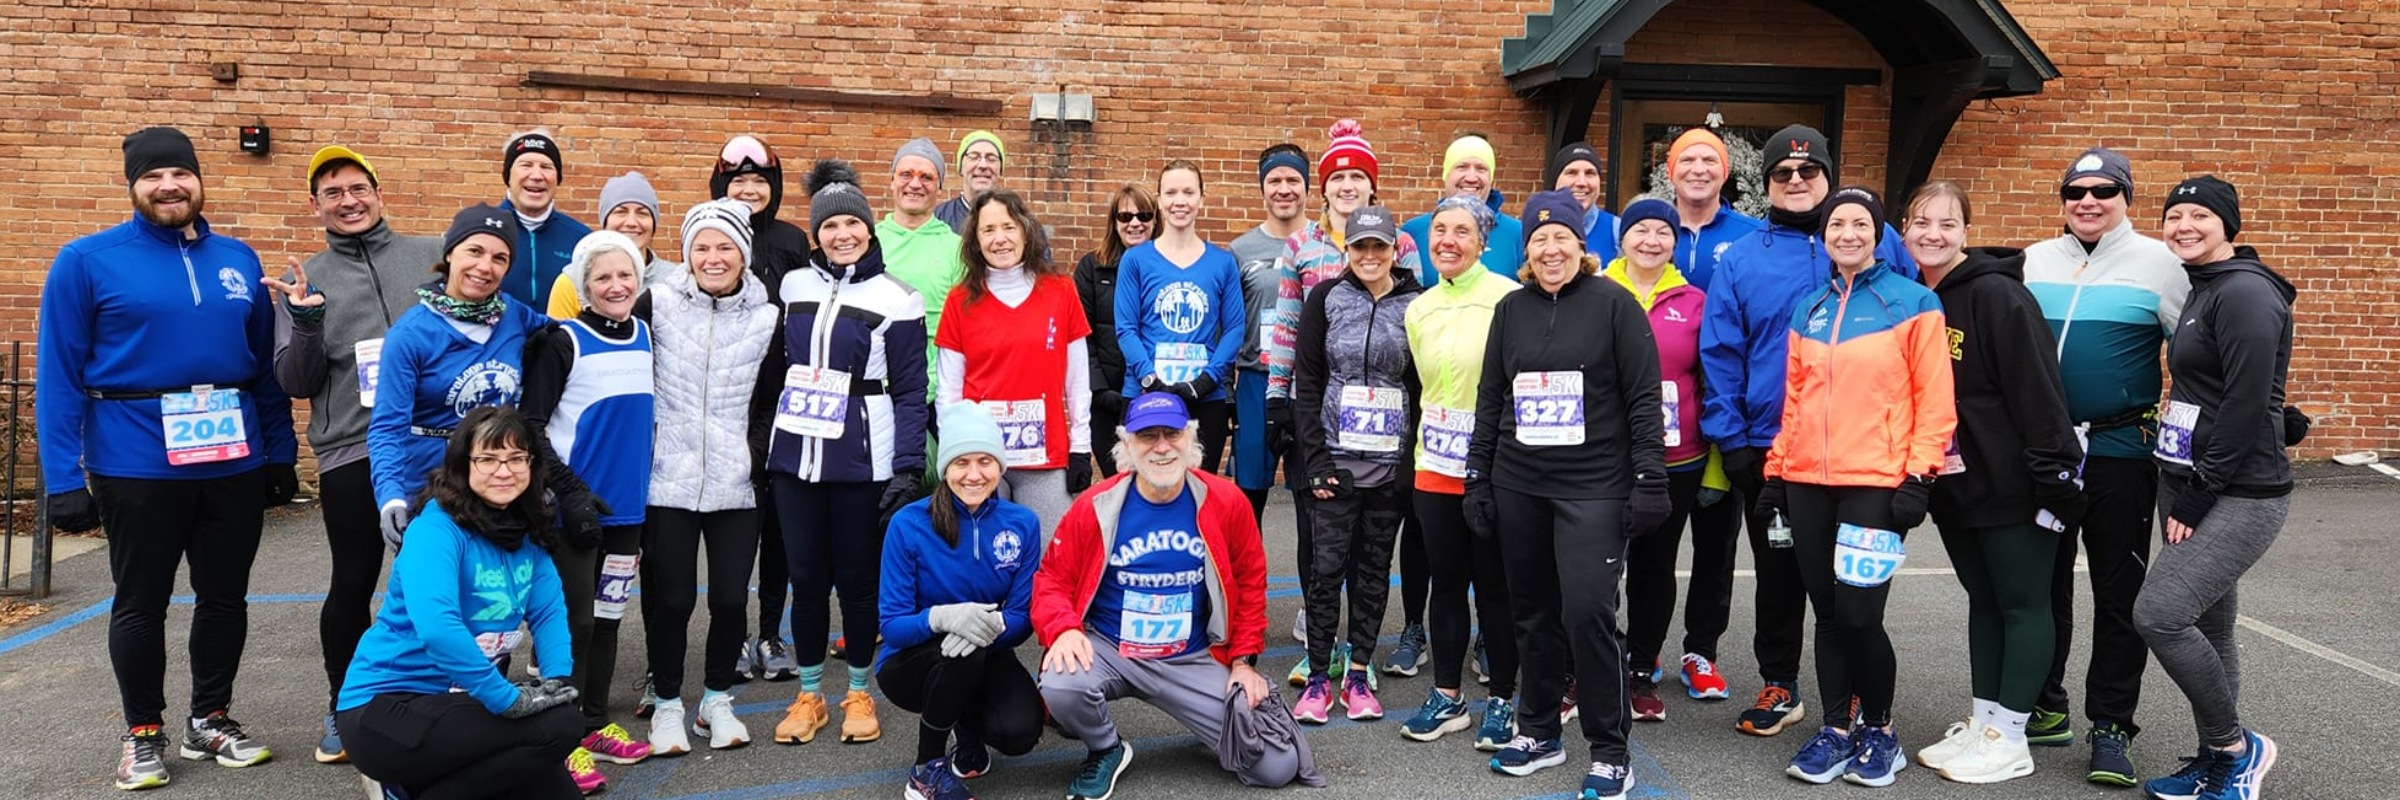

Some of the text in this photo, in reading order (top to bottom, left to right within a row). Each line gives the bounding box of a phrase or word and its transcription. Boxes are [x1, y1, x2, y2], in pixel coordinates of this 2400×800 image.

[820, 373, 848, 393] 5K
[1551, 375, 1578, 395] 5K
[208, 391, 235, 412] 5K
[788, 390, 840, 417] 517
[1377, 391, 1400, 408] 5K
[1016, 403, 1040, 421] 5K
[1354, 411, 1385, 431] 71
[1520, 400, 1576, 422] 327
[171, 416, 237, 442] 204
[1448, 411, 1474, 433] 5K
[1000, 424, 1039, 447] 76
[1425, 429, 1470, 457] 274
[1109, 529, 1206, 567] SARATOG
[1872, 532, 1899, 553] 5K
[1842, 554, 1896, 579] 167
[1117, 567, 1204, 588] STRYDERS
[1162, 595, 1186, 616] 5K
[1131, 619, 1183, 639] 177
